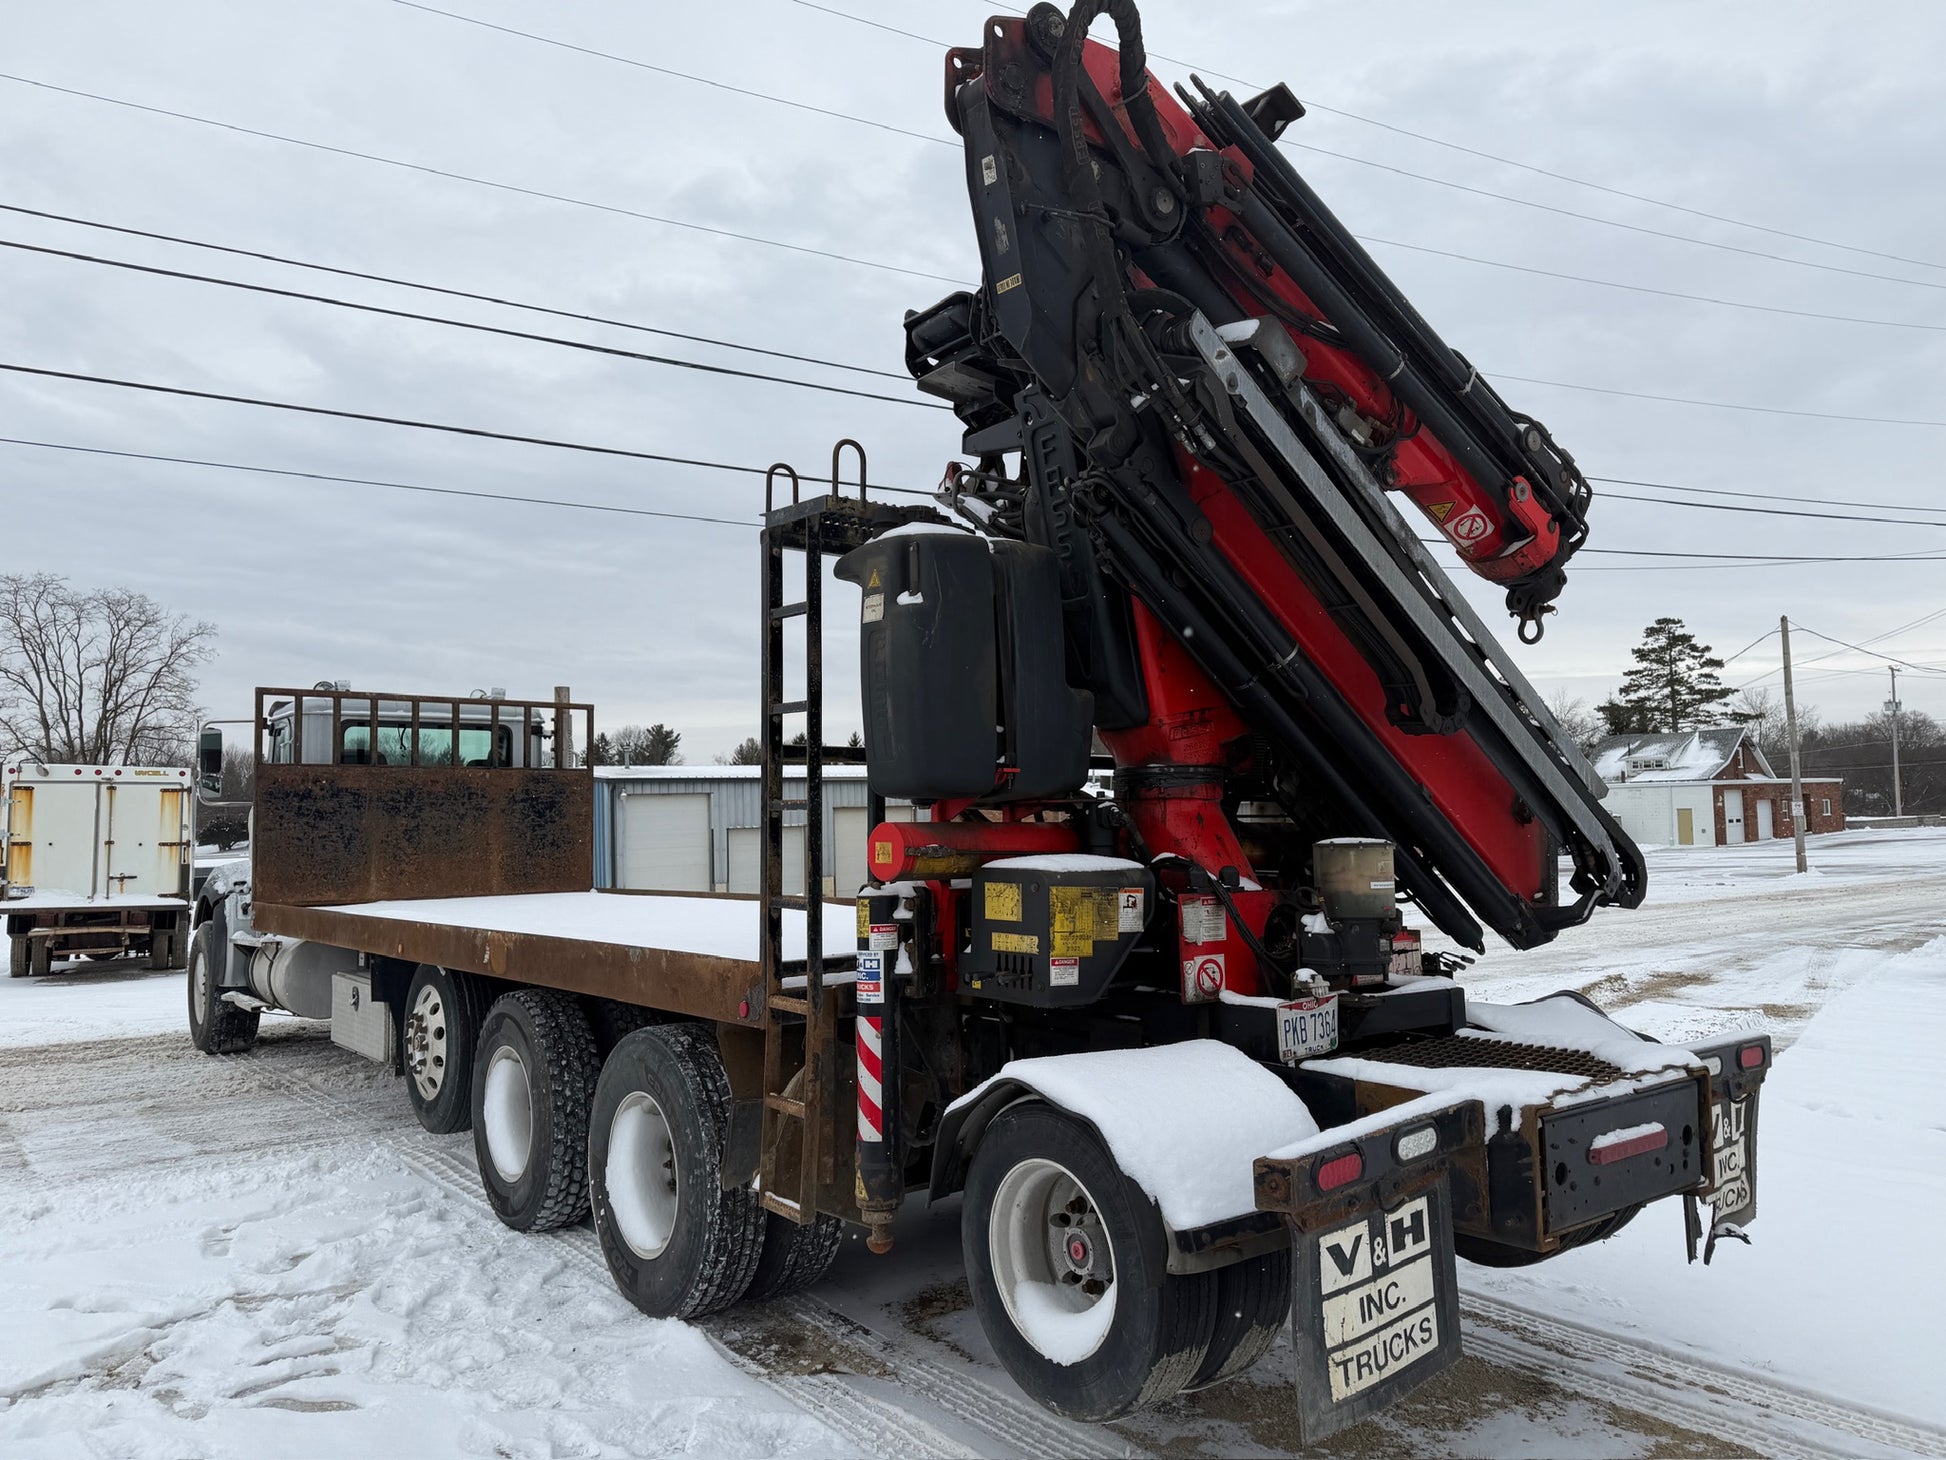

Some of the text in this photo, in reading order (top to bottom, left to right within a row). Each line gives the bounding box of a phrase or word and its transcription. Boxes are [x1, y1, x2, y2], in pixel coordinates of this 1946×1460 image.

[1284, 1009, 1336, 1048] PKB 7364
[1304, 1044, 1324, 1055] TRUCK
[1358, 1281, 1407, 1325] INC.
[1335, 1316, 1434, 1389] TRUCKS
